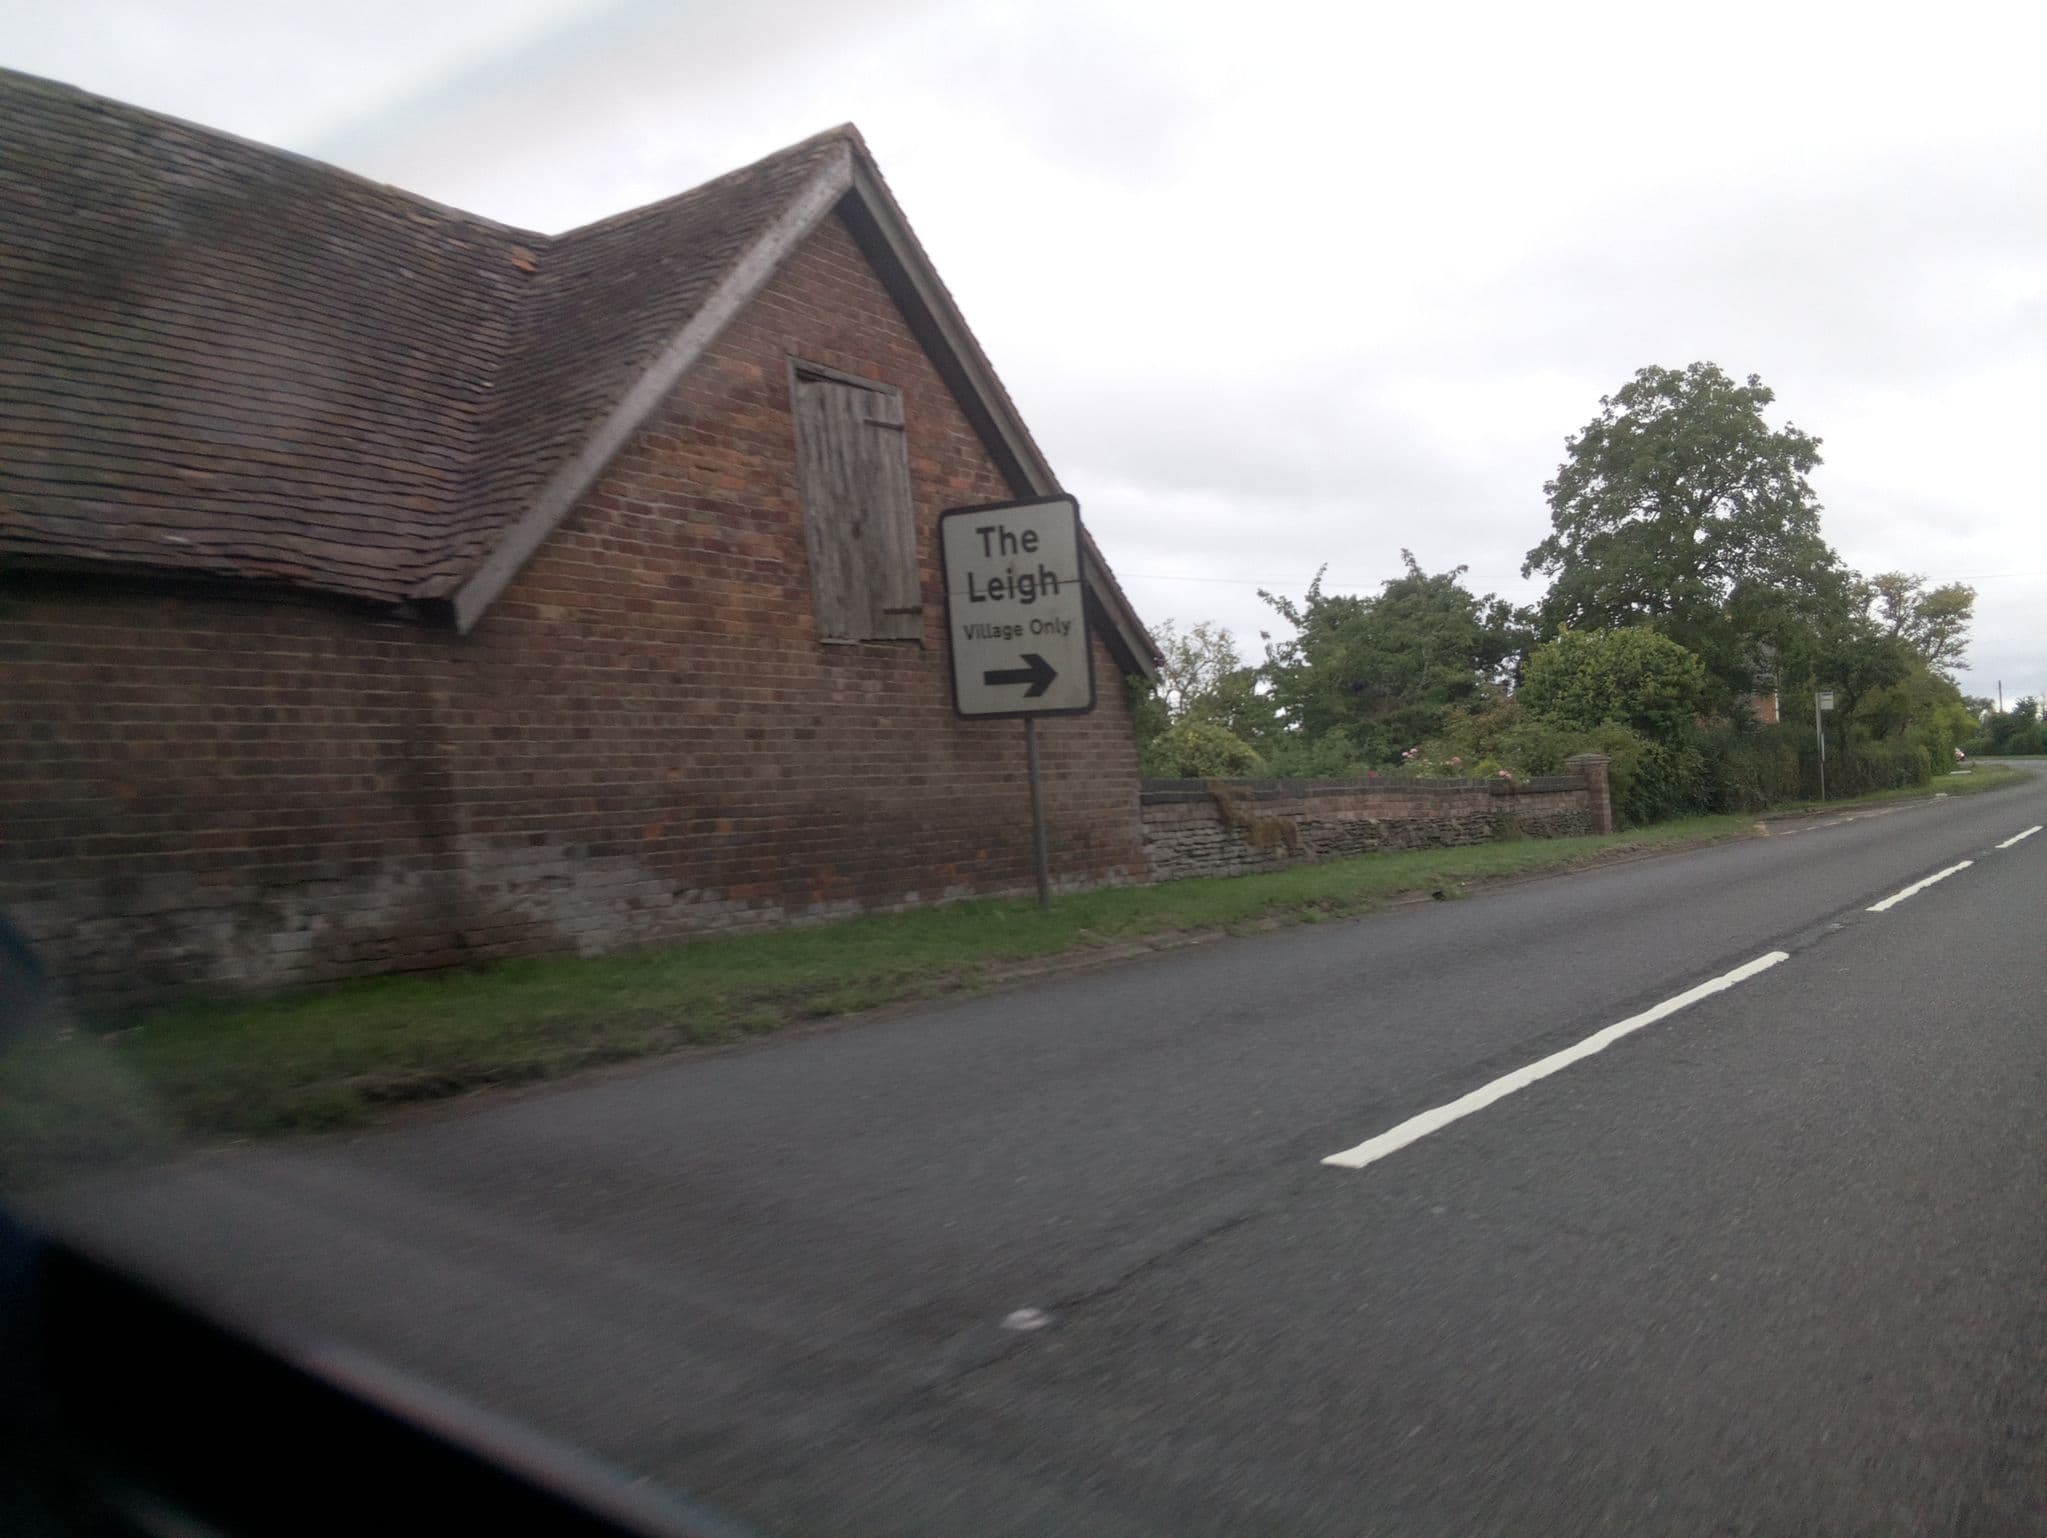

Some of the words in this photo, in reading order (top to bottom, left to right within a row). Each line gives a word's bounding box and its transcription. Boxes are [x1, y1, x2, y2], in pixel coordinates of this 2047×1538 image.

[975, 525, 1039, 558] The
[967, 564, 1060, 605] Leigh
[963, 623, 1024, 641] Village
[1029, 617, 1072, 637] Only
